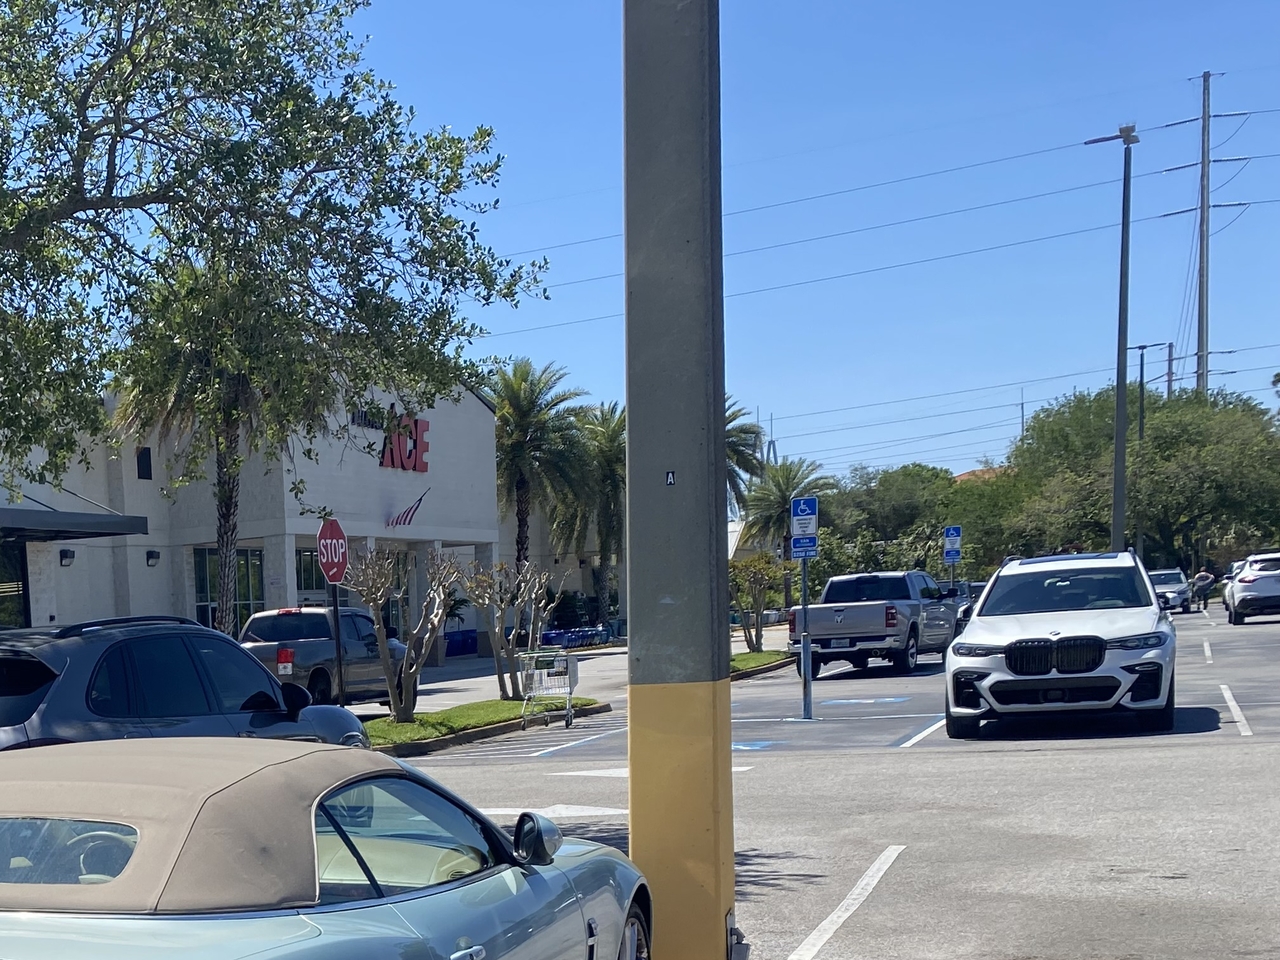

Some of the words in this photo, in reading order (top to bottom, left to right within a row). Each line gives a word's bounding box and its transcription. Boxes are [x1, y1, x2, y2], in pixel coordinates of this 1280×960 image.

[379, 402, 429, 472] ACE
[667, 472, 675, 485] A
[320, 538, 346, 563] STOP
